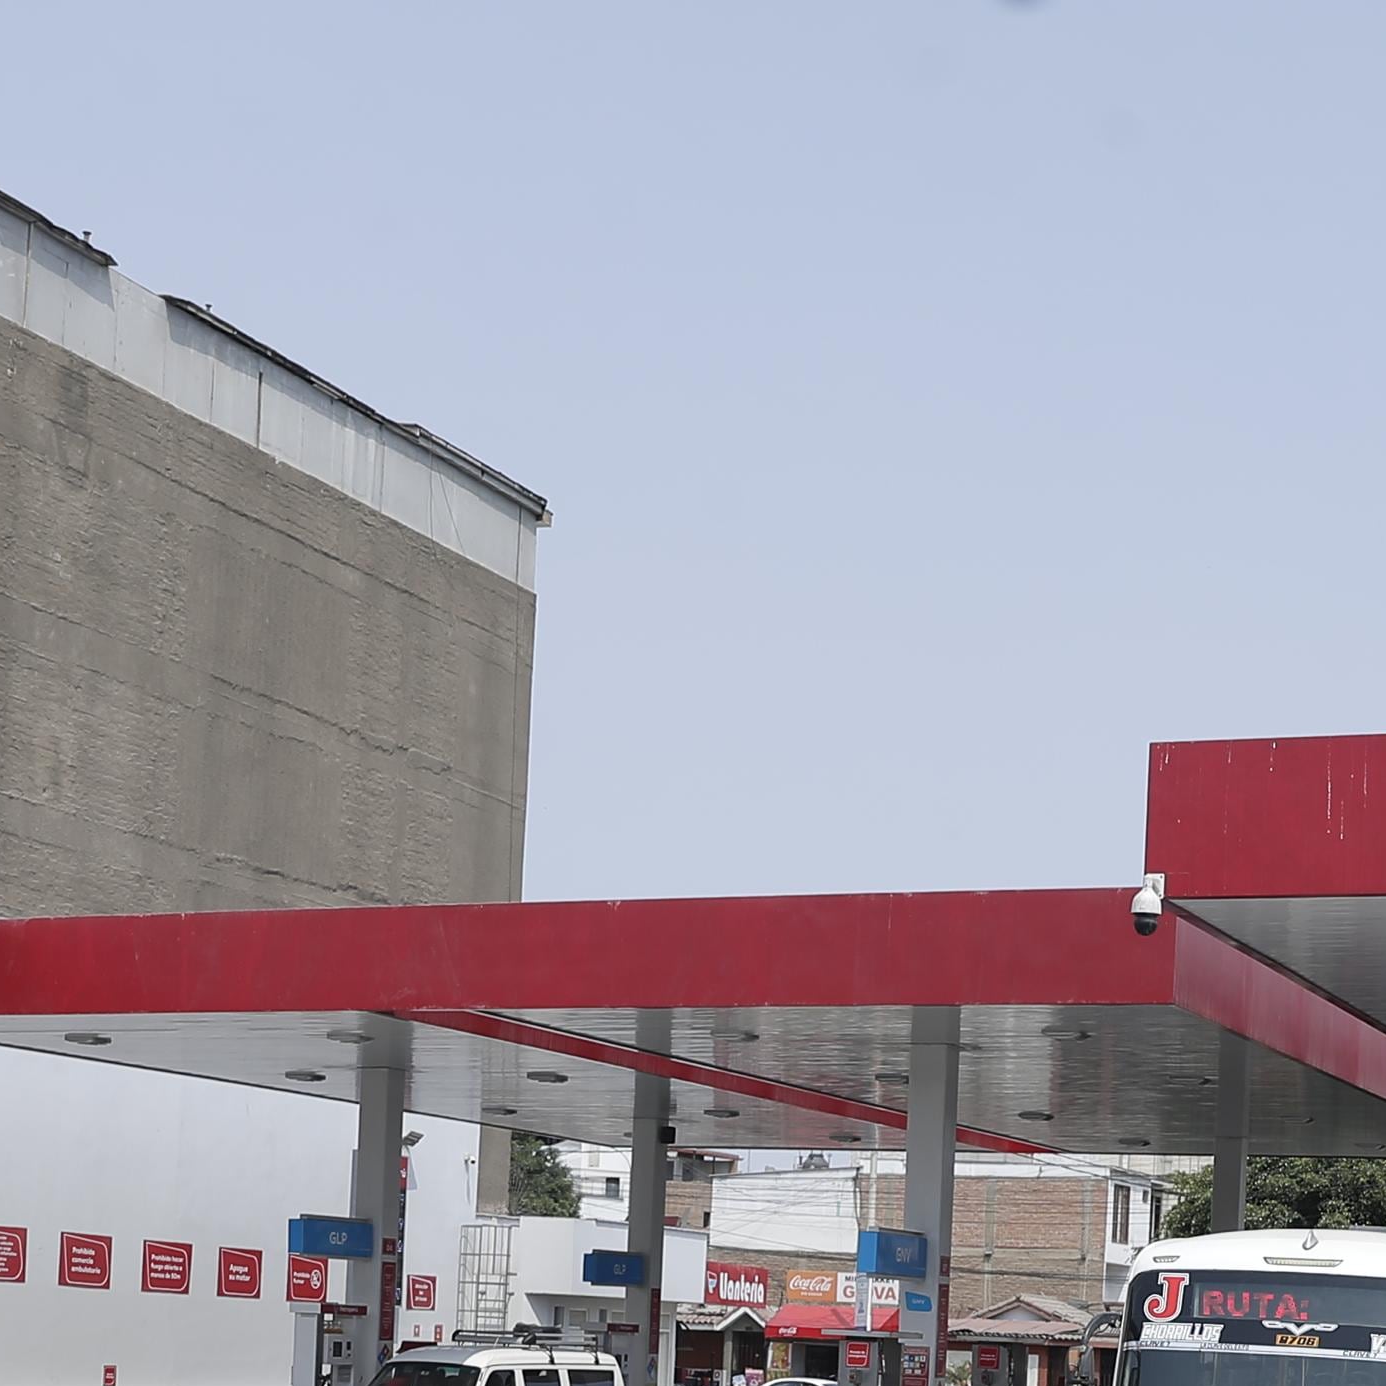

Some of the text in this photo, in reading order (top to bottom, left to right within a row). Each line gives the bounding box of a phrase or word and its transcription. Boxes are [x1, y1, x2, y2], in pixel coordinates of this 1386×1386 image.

[329, 1232, 347, 1245] GLP
[229, 1264, 248, 1274] Apague
[1201, 1289, 1310, 1321] RUTA:
[1139, 1322, 1225, 1344] CHORRILLOS
